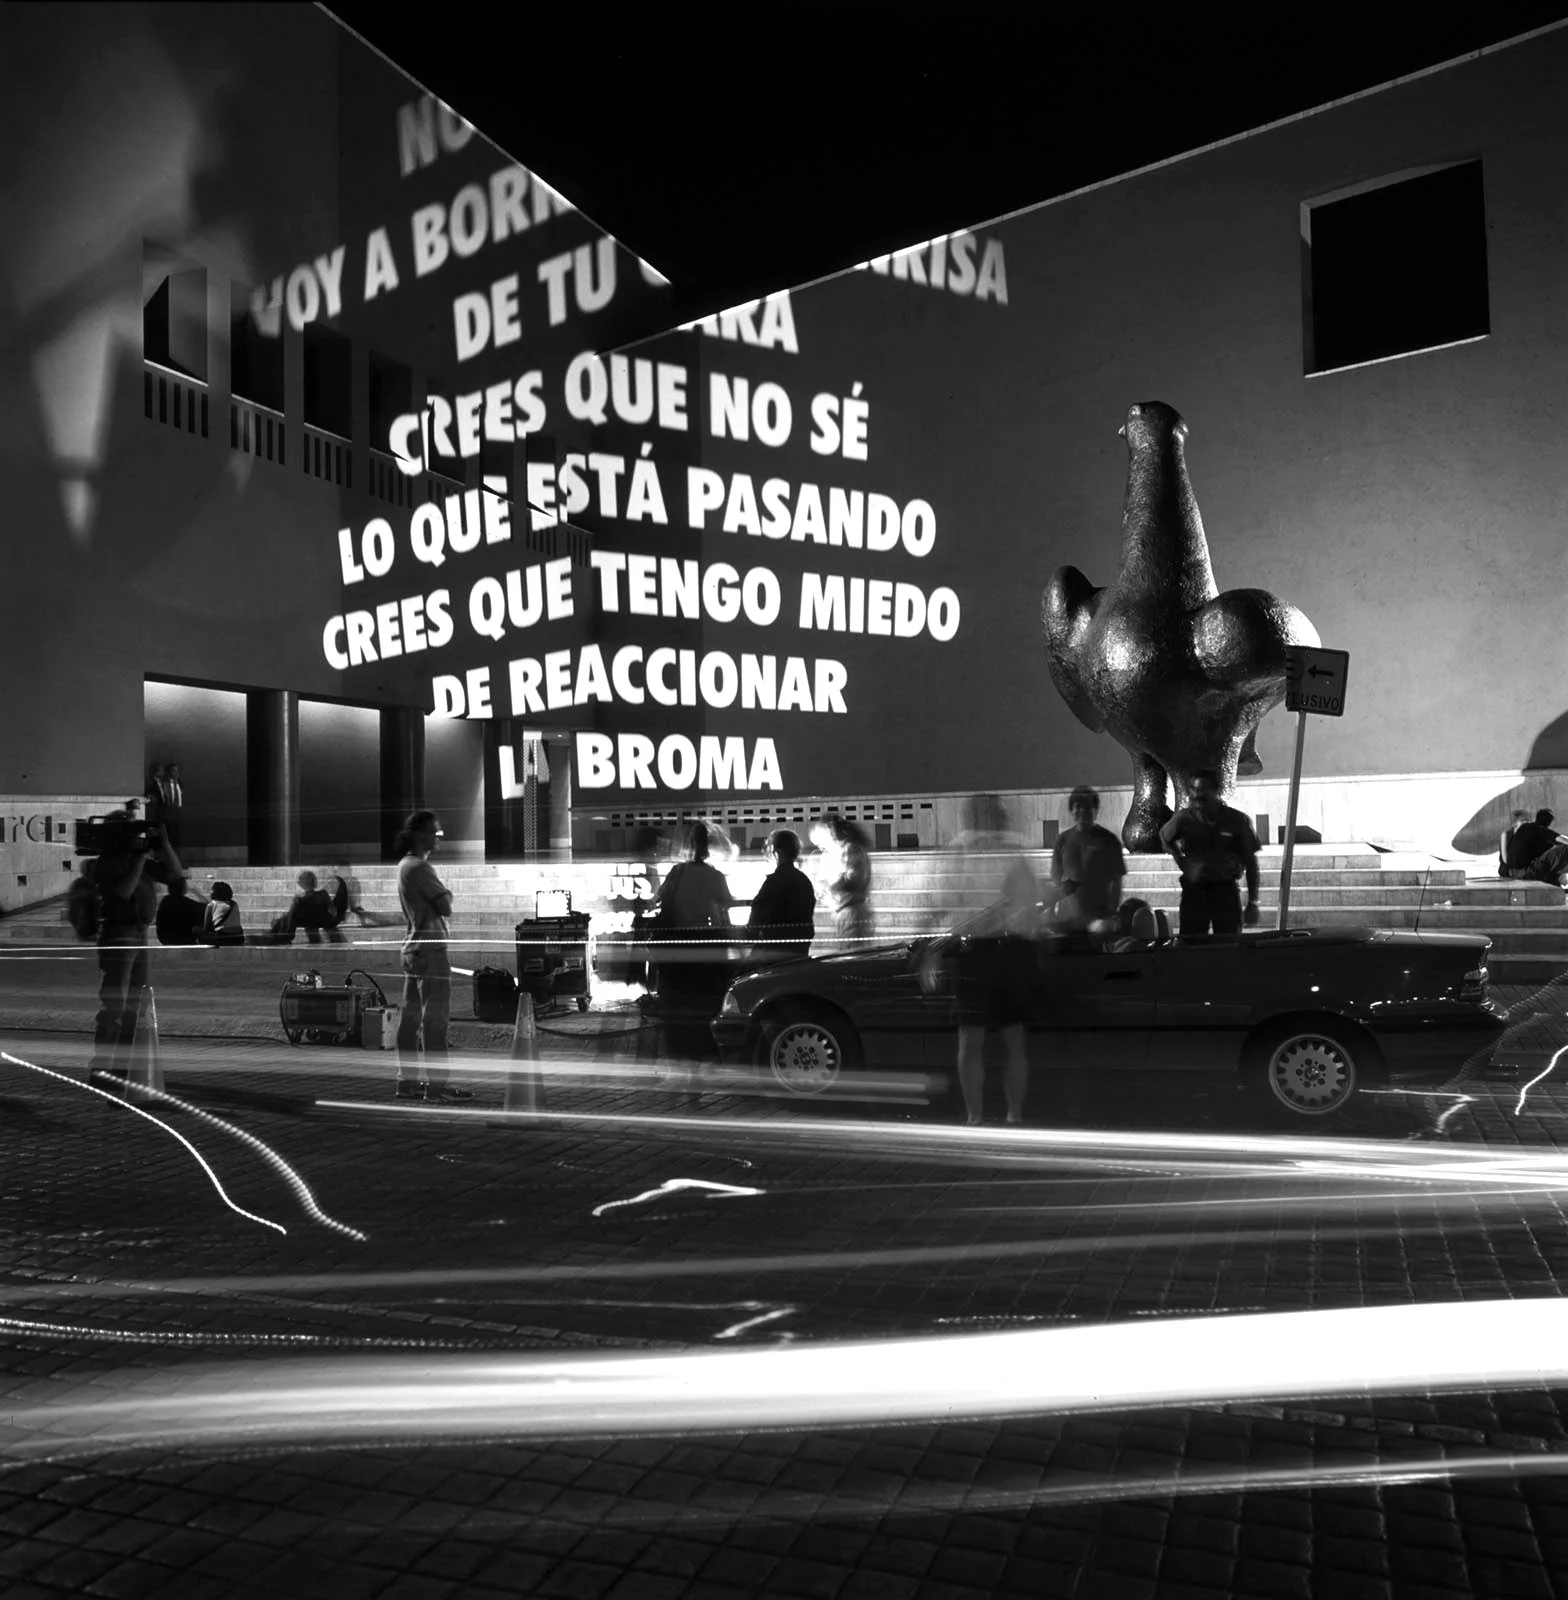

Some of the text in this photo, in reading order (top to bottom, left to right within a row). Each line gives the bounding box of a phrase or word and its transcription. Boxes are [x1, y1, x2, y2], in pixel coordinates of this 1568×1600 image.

[250, 244, 346, 337] VOY
[364, 225, 399, 301] A
[454, 273, 521, 362] DE
[538, 234, 616, 326] TU
[389, 351, 869, 476] CREES QUE NO SÉ
[338, 442, 936, 585] LO QUE ESTÁ PASANDO
[323, 549, 960, 670] CREES QUE TENGO MIEDO
[432, 643, 847, 719] DE REACCIONAR
[498, 731, 783, 800] LA BROMA
